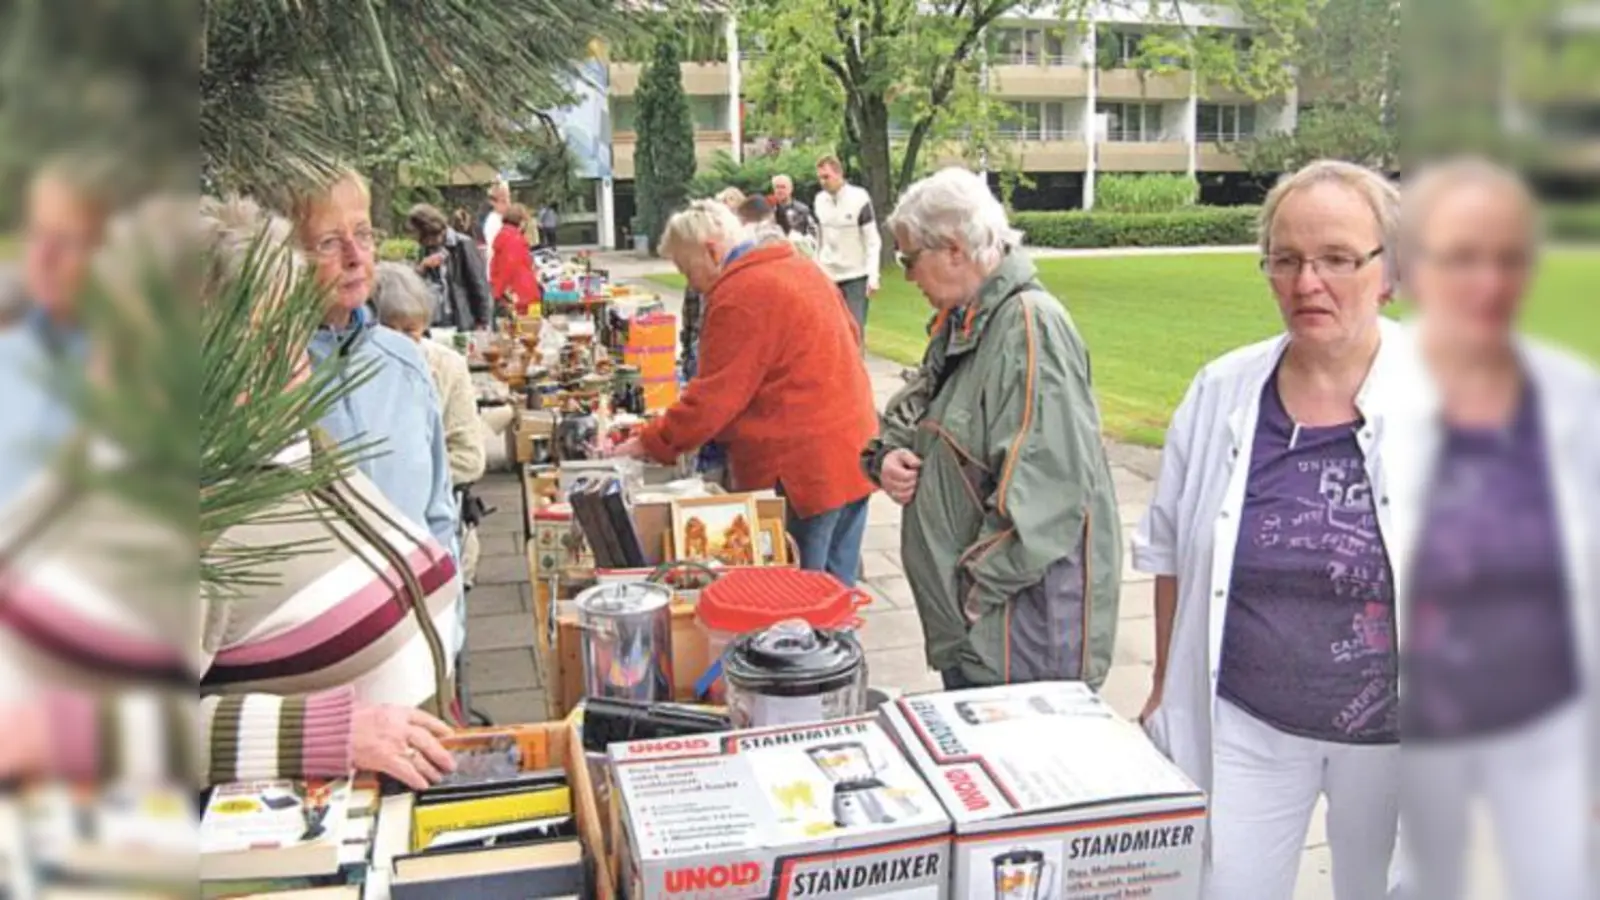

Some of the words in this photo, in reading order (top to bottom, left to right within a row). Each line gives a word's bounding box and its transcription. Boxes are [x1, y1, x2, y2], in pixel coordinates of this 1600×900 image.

[627, 739, 710, 754] UNOLD
[740, 723, 869, 751] STANDMIXER
[1069, 824, 1195, 860] STANDMIXER
[664, 860, 761, 893] UNOLD
[792, 852, 940, 897] STANDMIXER
